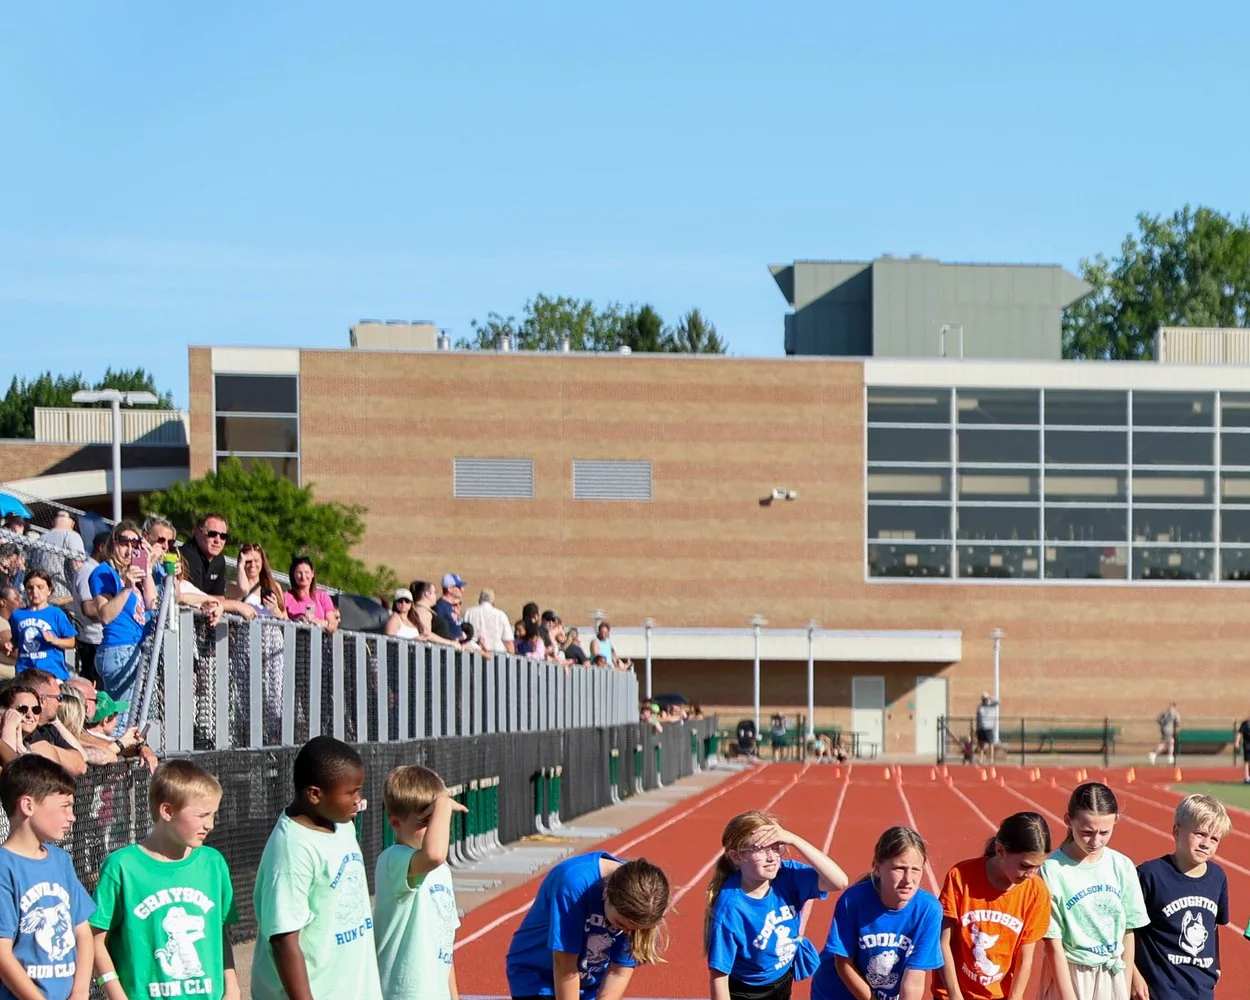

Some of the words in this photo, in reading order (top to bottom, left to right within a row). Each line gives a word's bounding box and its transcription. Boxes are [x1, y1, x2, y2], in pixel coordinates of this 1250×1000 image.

[133, 887, 215, 920] GRAYSON
[335, 928, 357, 945] RUN
[27, 965, 54, 979] RUN
[149, 981, 181, 997] RUN
